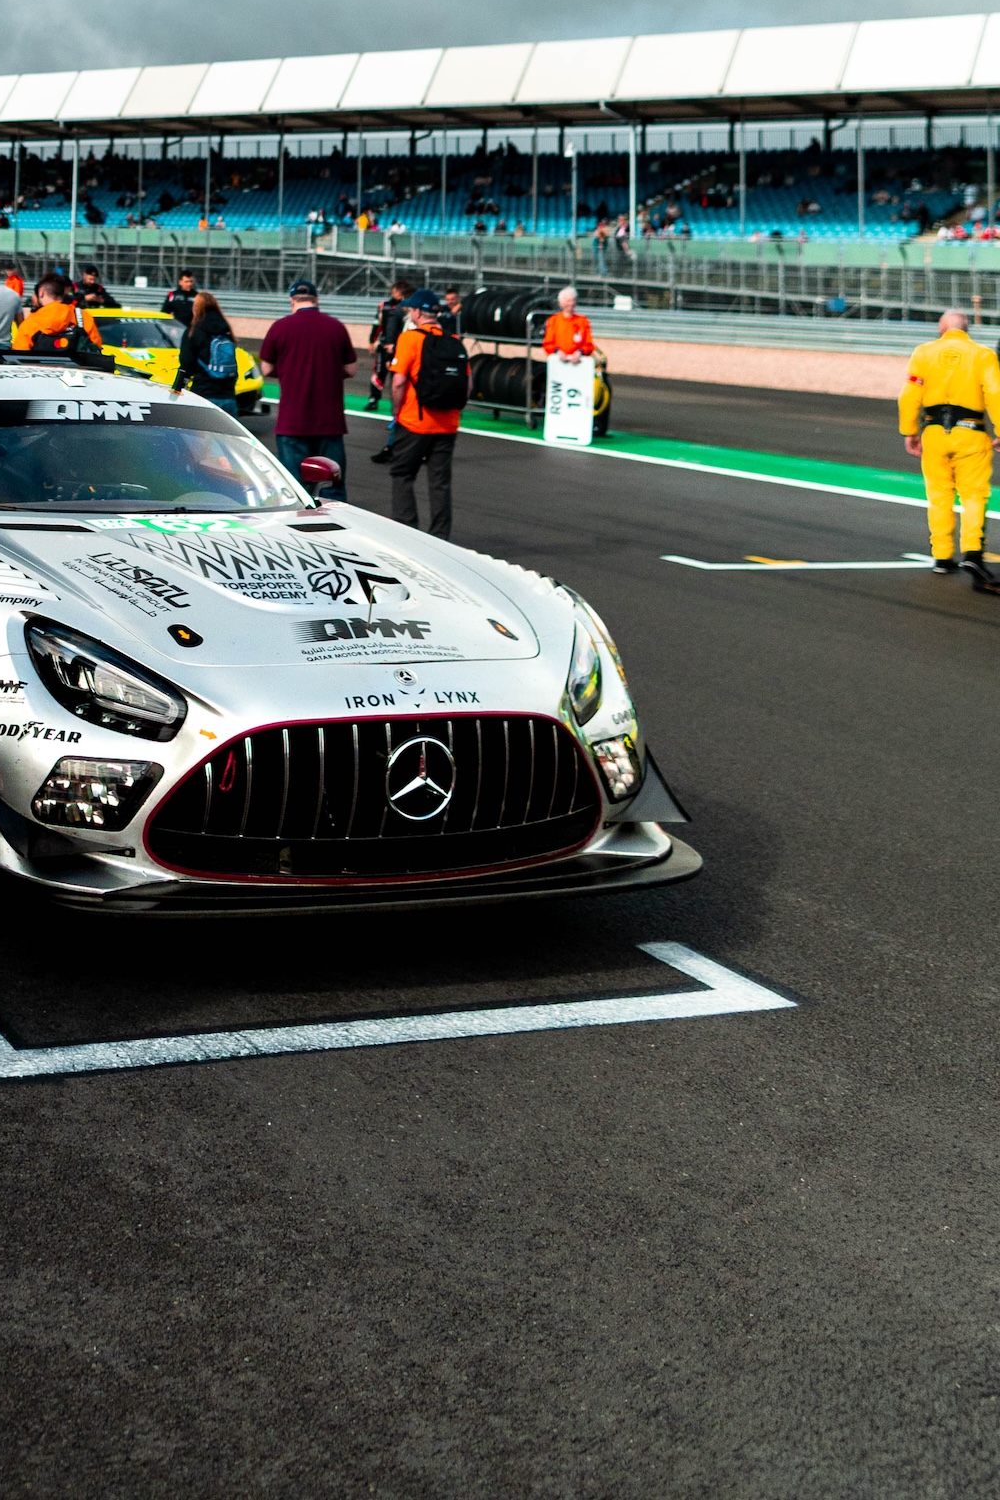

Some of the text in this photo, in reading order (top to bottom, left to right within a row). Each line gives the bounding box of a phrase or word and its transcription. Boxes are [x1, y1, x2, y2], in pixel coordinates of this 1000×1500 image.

[550, 380, 563, 415] ROW
[566, 388, 582, 408] 19
[34, 400, 151, 422] QMMF
[150, 518, 250, 533] 62
[74, 557, 172, 613] INTERNATIONAL CIRCUIT
[250, 572, 298, 581] QATAR
[296, 618, 432, 643] QMMF
[306, 654, 334, 662] QATAR
[335, 651, 363, 659] MOTOR
[371, 649, 422, 657] MOTORCYCLE
[422, 650, 465, 658] FEDERATION
[344, 690, 481, 709] IRON LYNX
